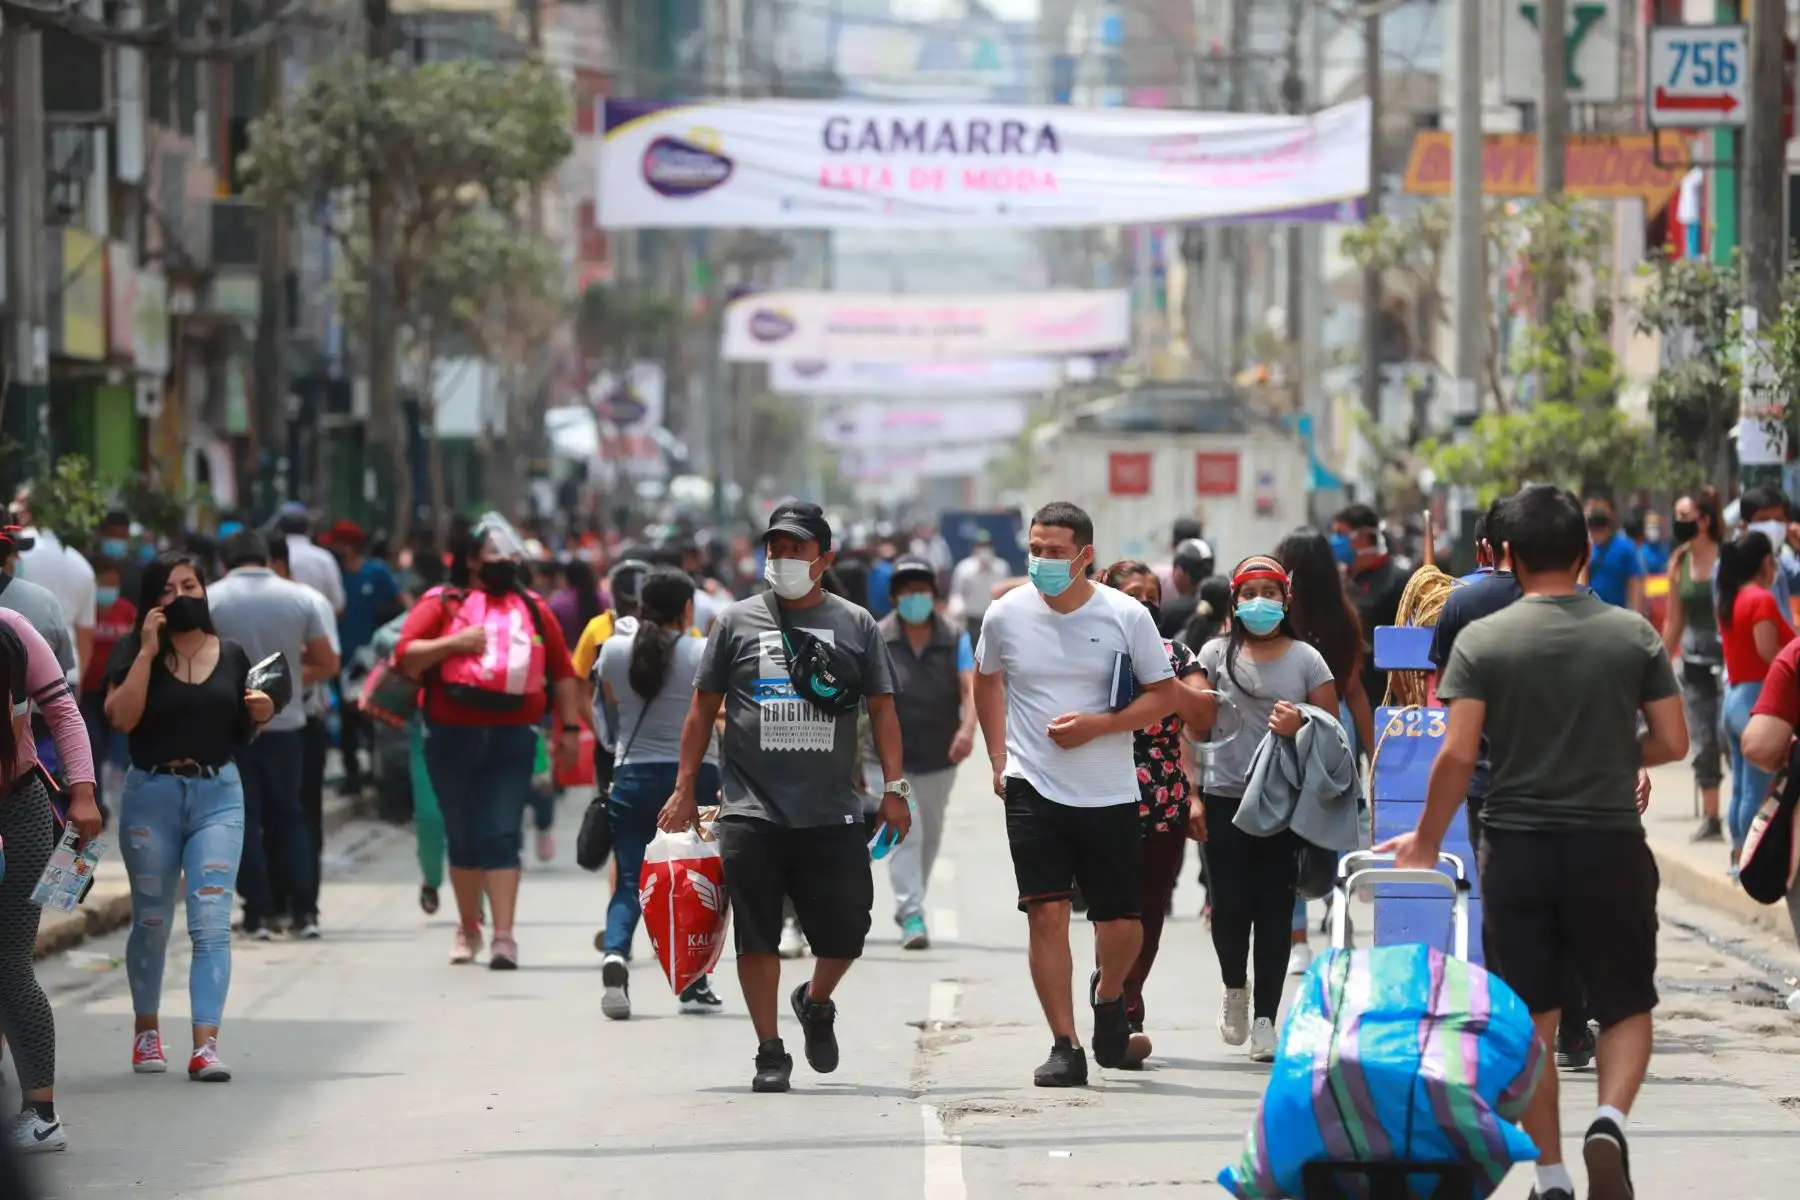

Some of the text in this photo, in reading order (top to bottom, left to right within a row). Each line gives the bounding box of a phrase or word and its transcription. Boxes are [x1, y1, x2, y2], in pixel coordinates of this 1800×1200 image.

[1667, 41, 1738, 87] 756
[822, 117, 1061, 154] GAMARRA
[909, 166, 945, 191] DE
[963, 167, 1059, 193] MODA
[1387, 709, 1446, 737] 323
